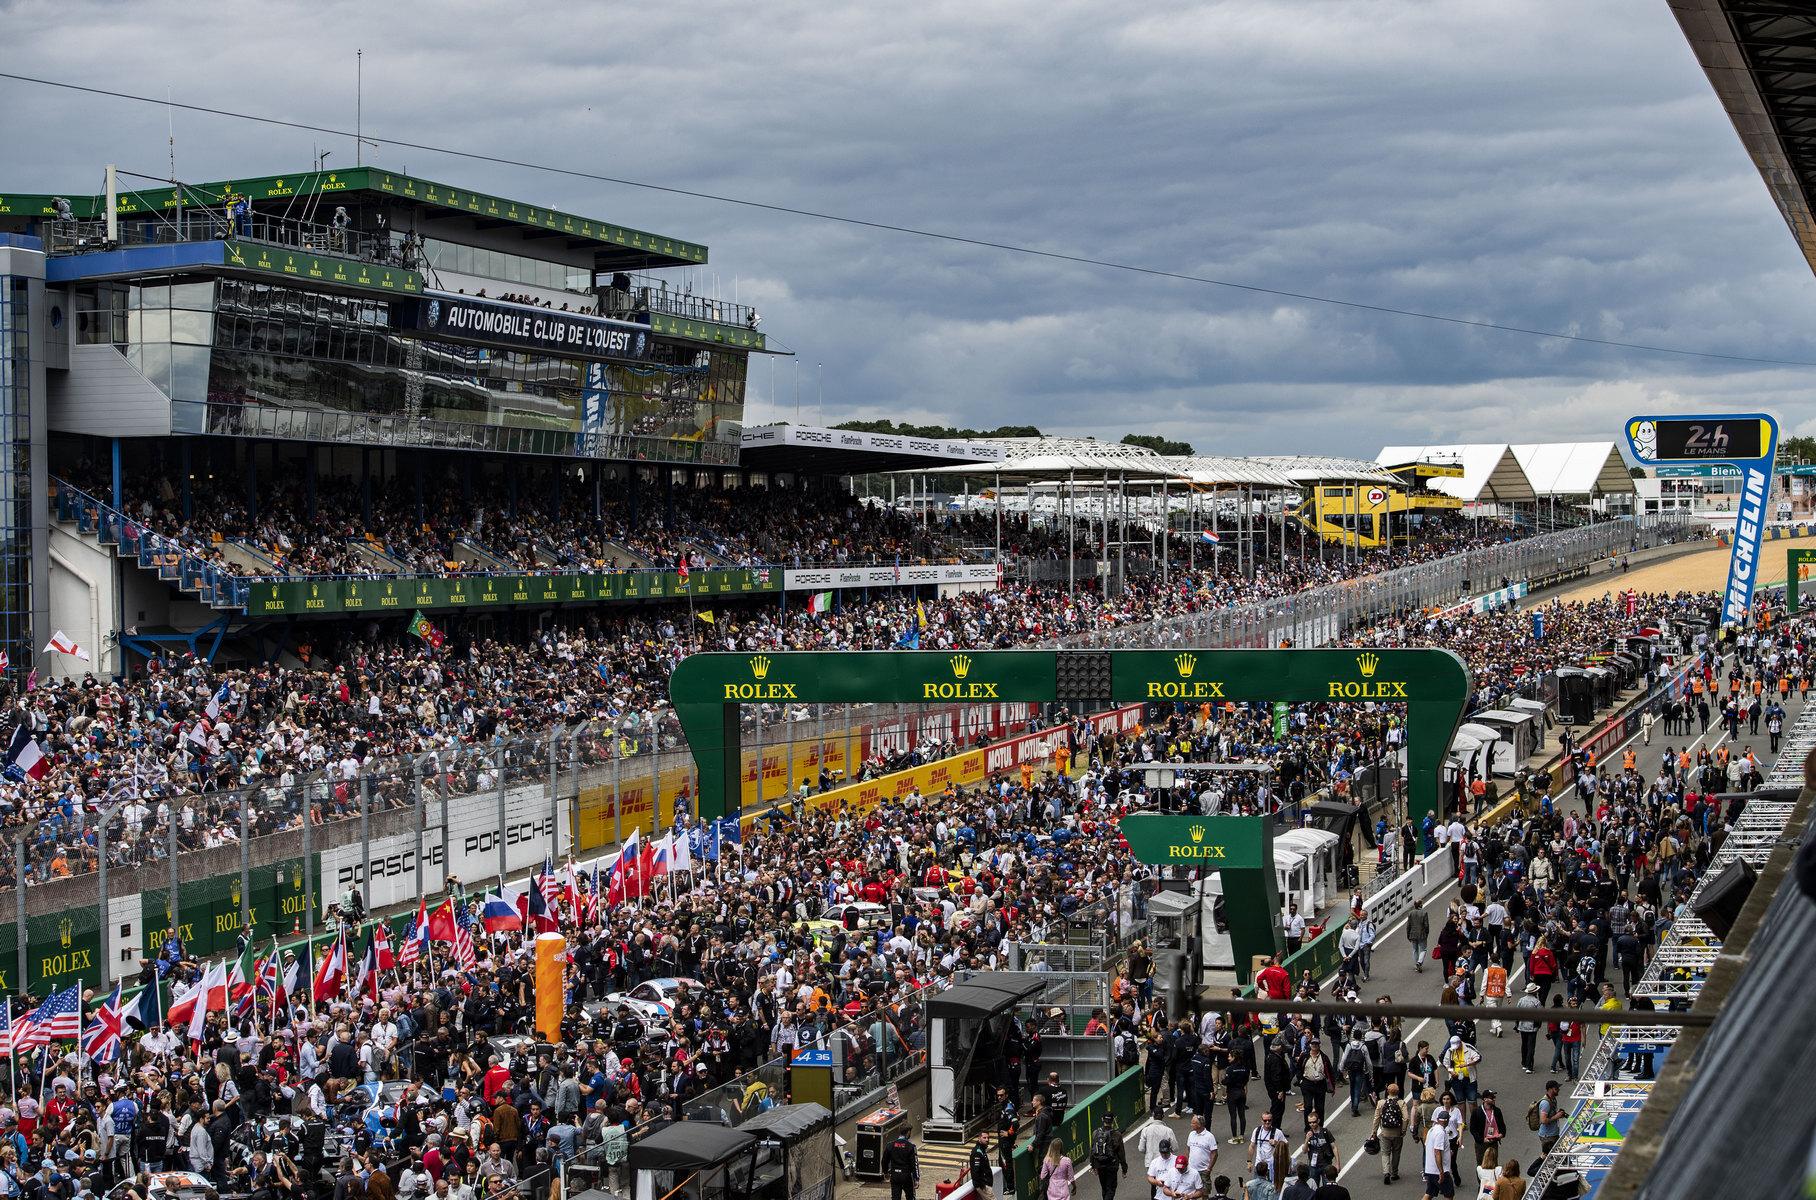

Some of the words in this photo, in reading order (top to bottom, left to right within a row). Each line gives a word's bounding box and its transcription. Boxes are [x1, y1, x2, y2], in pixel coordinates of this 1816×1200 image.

[321, 182, 346, 190] ROLEX
[268, 188, 293, 196] ROLEX
[165, 199, 188, 207] ROLX
[448, 306, 530, 336] AUTOMOBILE
[534, 319, 564, 342] CLUB
[568, 325, 583, 346] DE
[586, 328, 631, 351] L'OUEST
[742, 432, 775, 442] CHE
[796, 431, 832, 442] PORSCHE
[871, 437, 902, 449] PORSCHE
[909, 441, 940, 452] PORSCHE
[972, 447, 998, 458] PORSCHE
[1727, 468, 1766, 626] MICHELIN
[795, 574, 830, 584] PORSCHE
[870, 572, 900, 581] PORSCH
[909, 571, 938, 580] PORSCHE
[970, 568, 995, 577] PORSCHE
[513, 590, 528, 600] ROLEX
[543, 590, 557, 600] ROLEX
[572, 589, 585, 598] ROLEX
[599, 588, 612, 597] ROLEX
[625, 587, 637, 596] ROLEX
[345, 598, 363, 607] ROLEX
[381, 597, 398, 606] ROLEX
[416, 596, 433, 605] ROLEX
[450, 594, 466, 603] ROLEX
[482, 593, 498, 602] ROLEX
[265, 601, 285, 610] ROLEX
[306, 599, 325, 609] ROLEX
[724, 684, 798, 698] ROLEX
[923, 683, 999, 698] ROLEX
[1147, 682, 1225, 698] ROLEX
[1328, 682, 1408, 698] ROLEX
[988, 746, 1012, 773] MOTUL
[465, 818, 552, 857] PORSCHE
[1169, 846, 1225, 858] ROLEX
[338, 844, 442, 884] PORSCHE
[42, 950, 91, 978] ROLEX
[150, 923, 193, 950] ROEX
[216, 908, 256, 932] ROLX
[1584, 1122, 1605, 1136] 47
